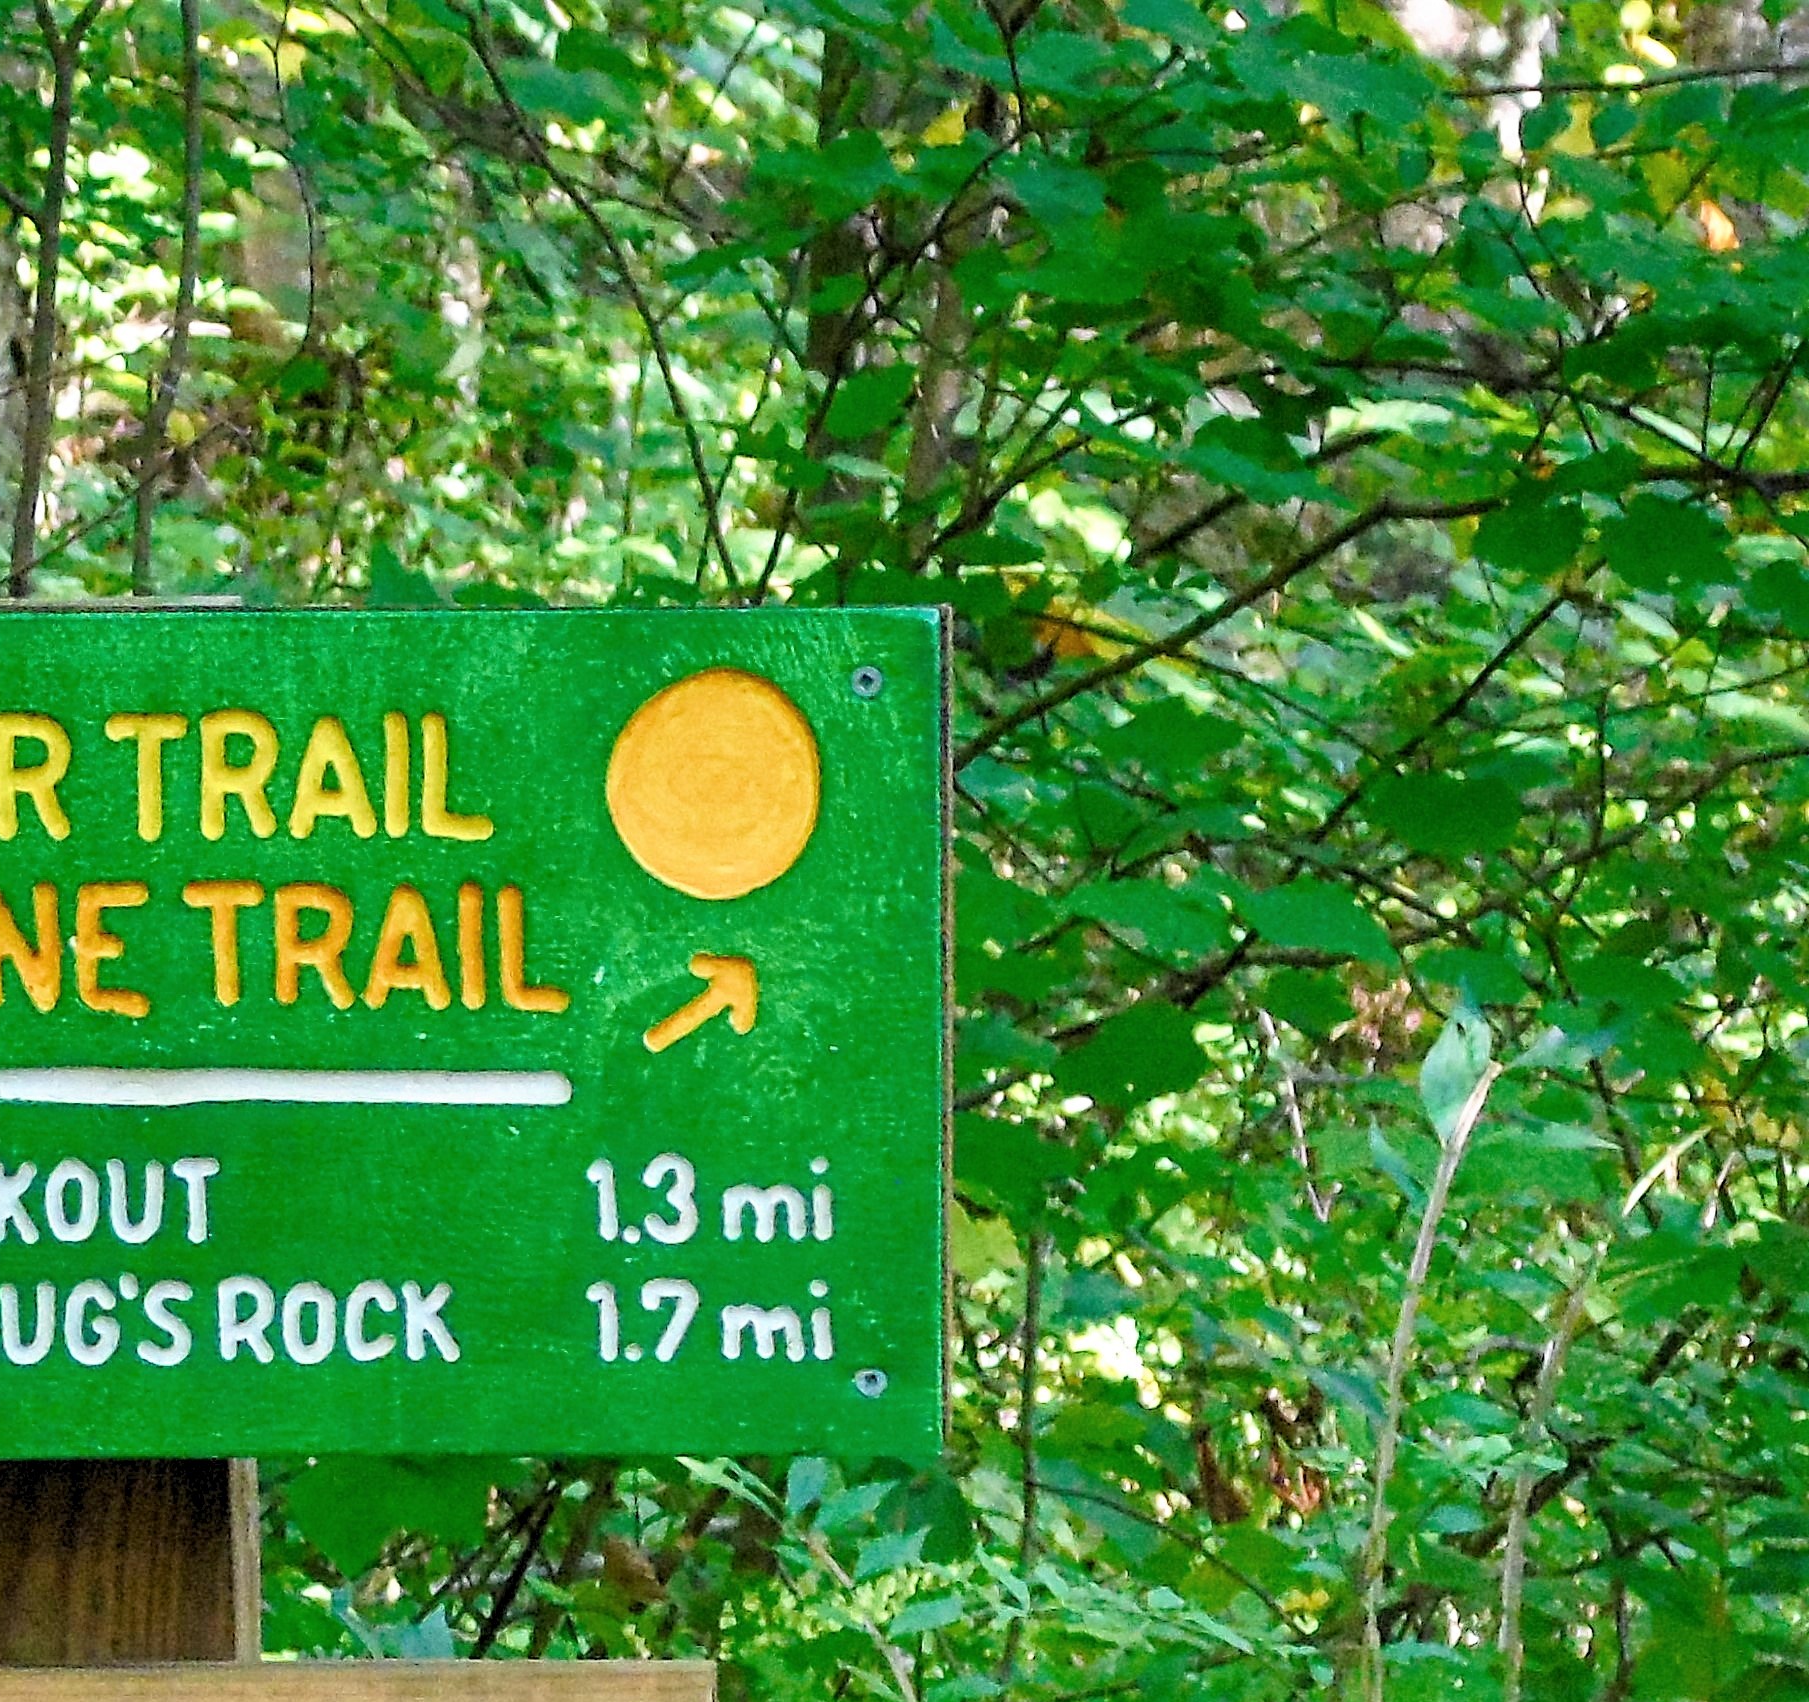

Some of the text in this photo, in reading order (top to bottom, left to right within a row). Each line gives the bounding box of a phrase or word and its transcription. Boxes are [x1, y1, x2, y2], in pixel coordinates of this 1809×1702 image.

[104, 709, 494, 841] TRAIL
[182, 880, 570, 1014] TRAIL
[586, 1152, 833, 1244] 1.3 mi
[218, 1275, 460, 1363] ROCK
[586, 1278, 833, 1362] 1.7 mi
